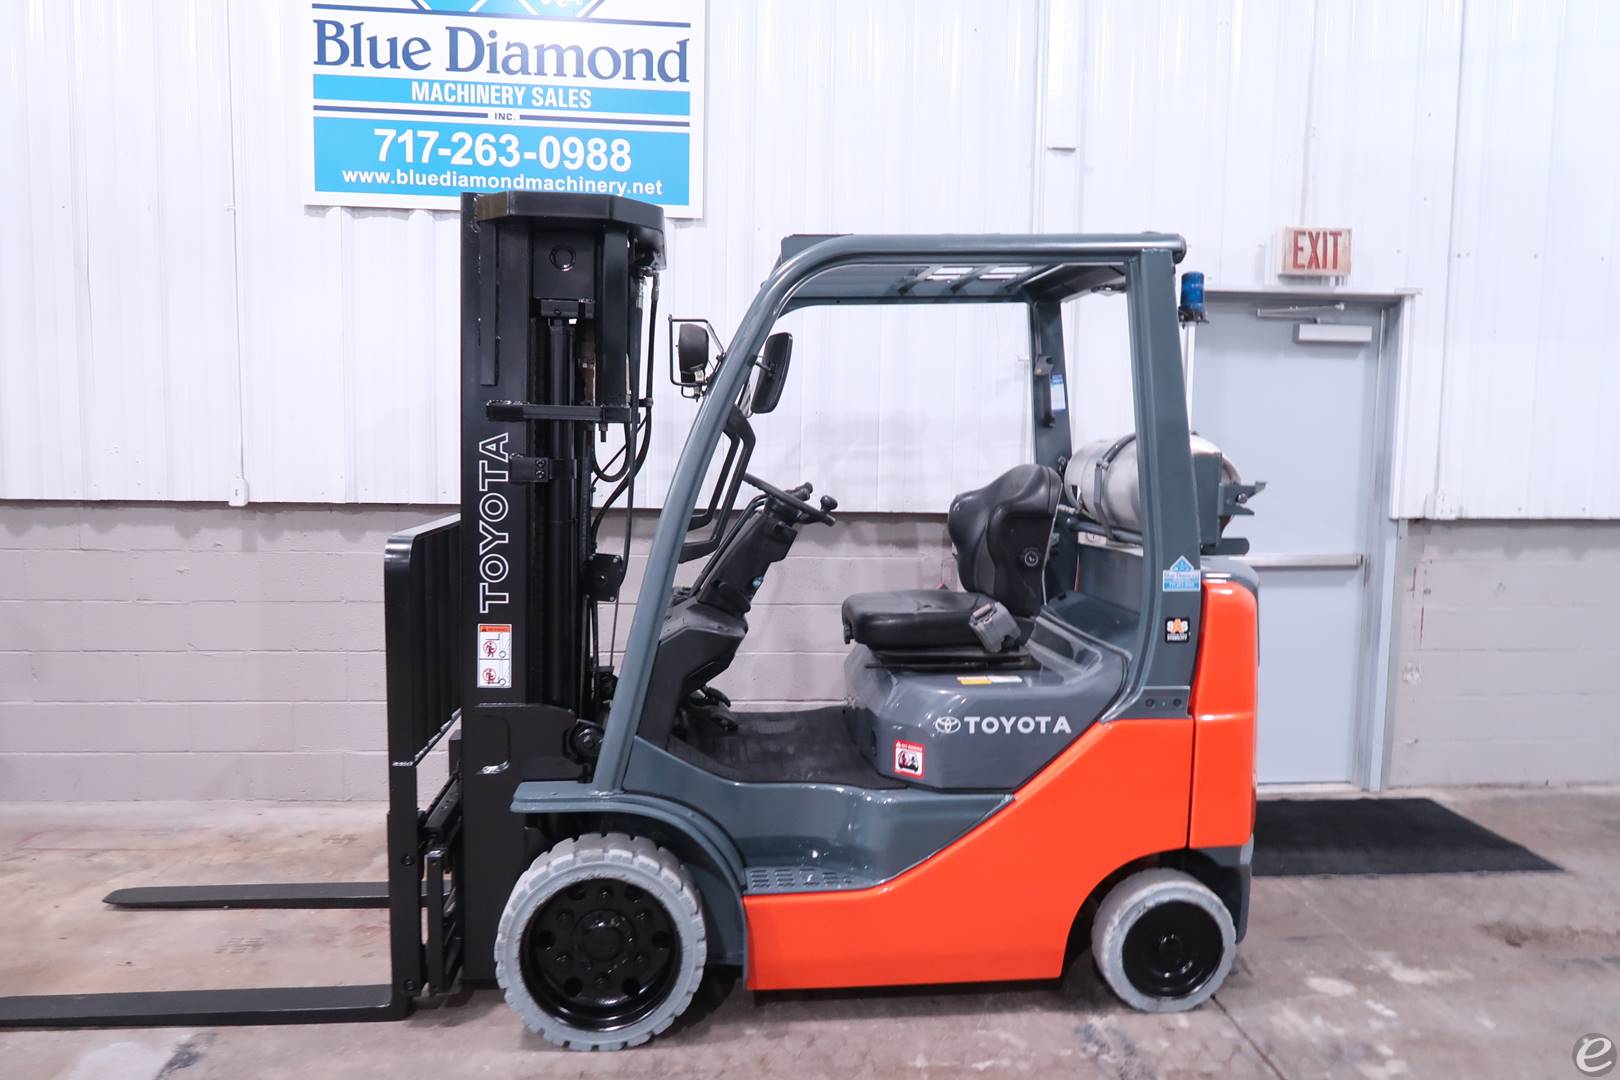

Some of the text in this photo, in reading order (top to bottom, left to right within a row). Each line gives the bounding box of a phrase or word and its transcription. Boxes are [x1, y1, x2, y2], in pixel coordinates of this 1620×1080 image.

[313, 19, 690, 83] Blue Diamond
[411, 81, 592, 109] MACHINERY SALES
[494, 112, 516, 121] INC.
[374, 128, 632, 172] 717-263-0988
[342, 169, 663, 195] www.bluediamondmachinery.net
[1293, 230, 1342, 270] EXIT
[479, 432, 509, 613] TOYOTA
[964, 716, 1072, 734] TOYOTA
